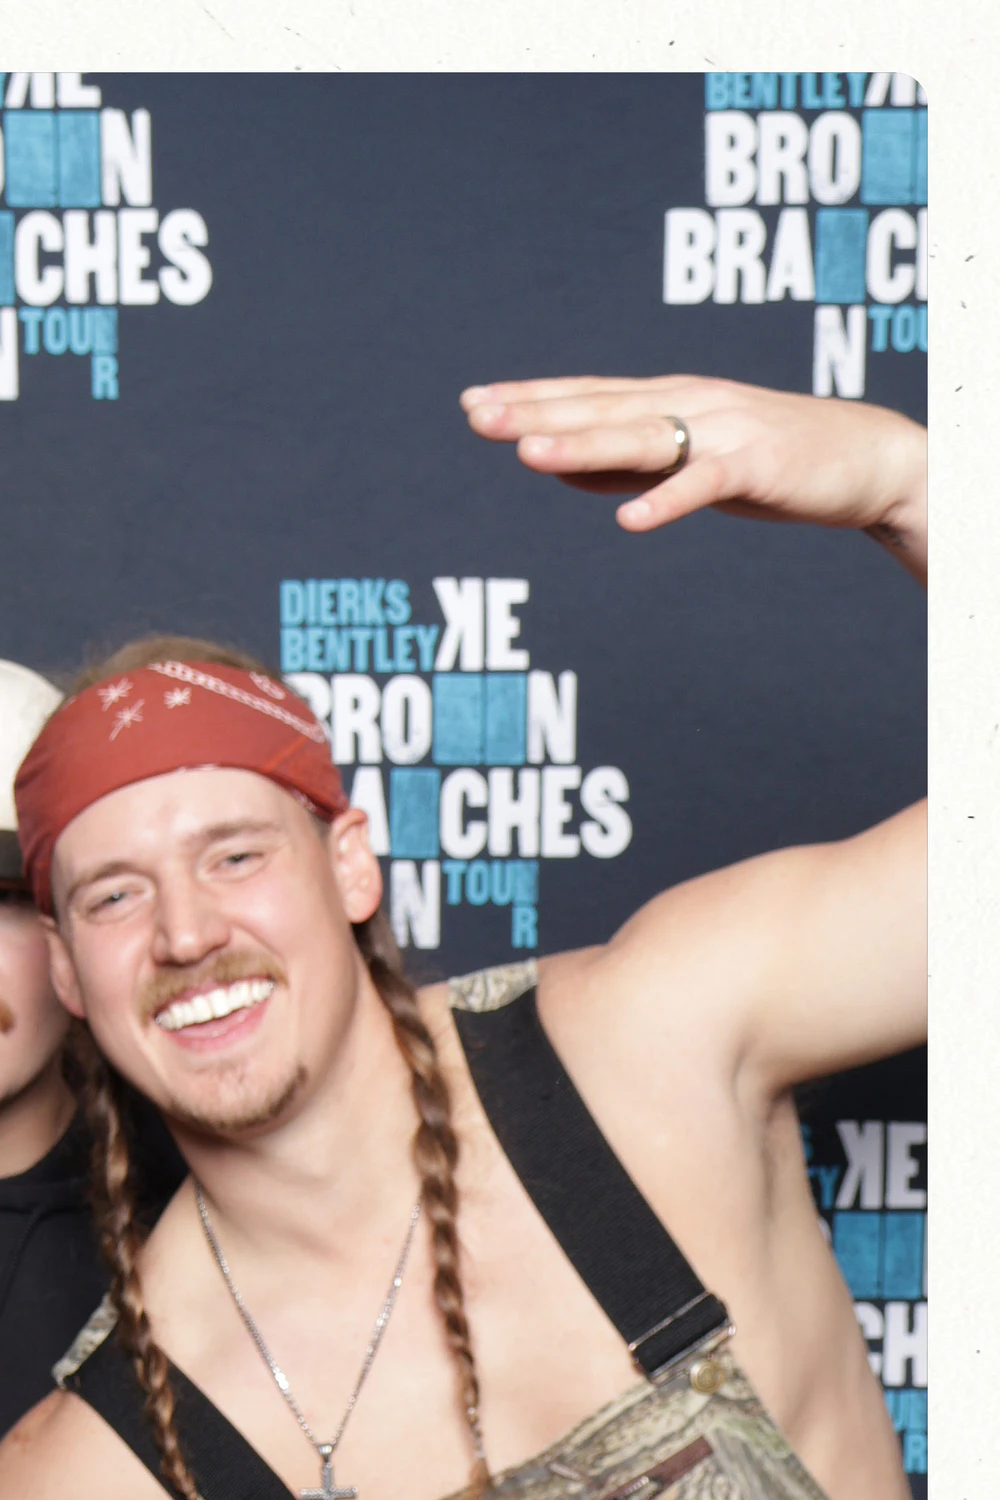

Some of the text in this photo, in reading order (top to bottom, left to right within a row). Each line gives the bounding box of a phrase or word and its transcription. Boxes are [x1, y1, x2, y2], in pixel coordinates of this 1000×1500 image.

[705, 72, 866, 109] BENTLEY
[705, 109, 862, 207] BRO
[812, 304, 866, 399] N
[280, 578, 412, 627] DIERKS
[280, 624, 439, 673] BENTLEY
